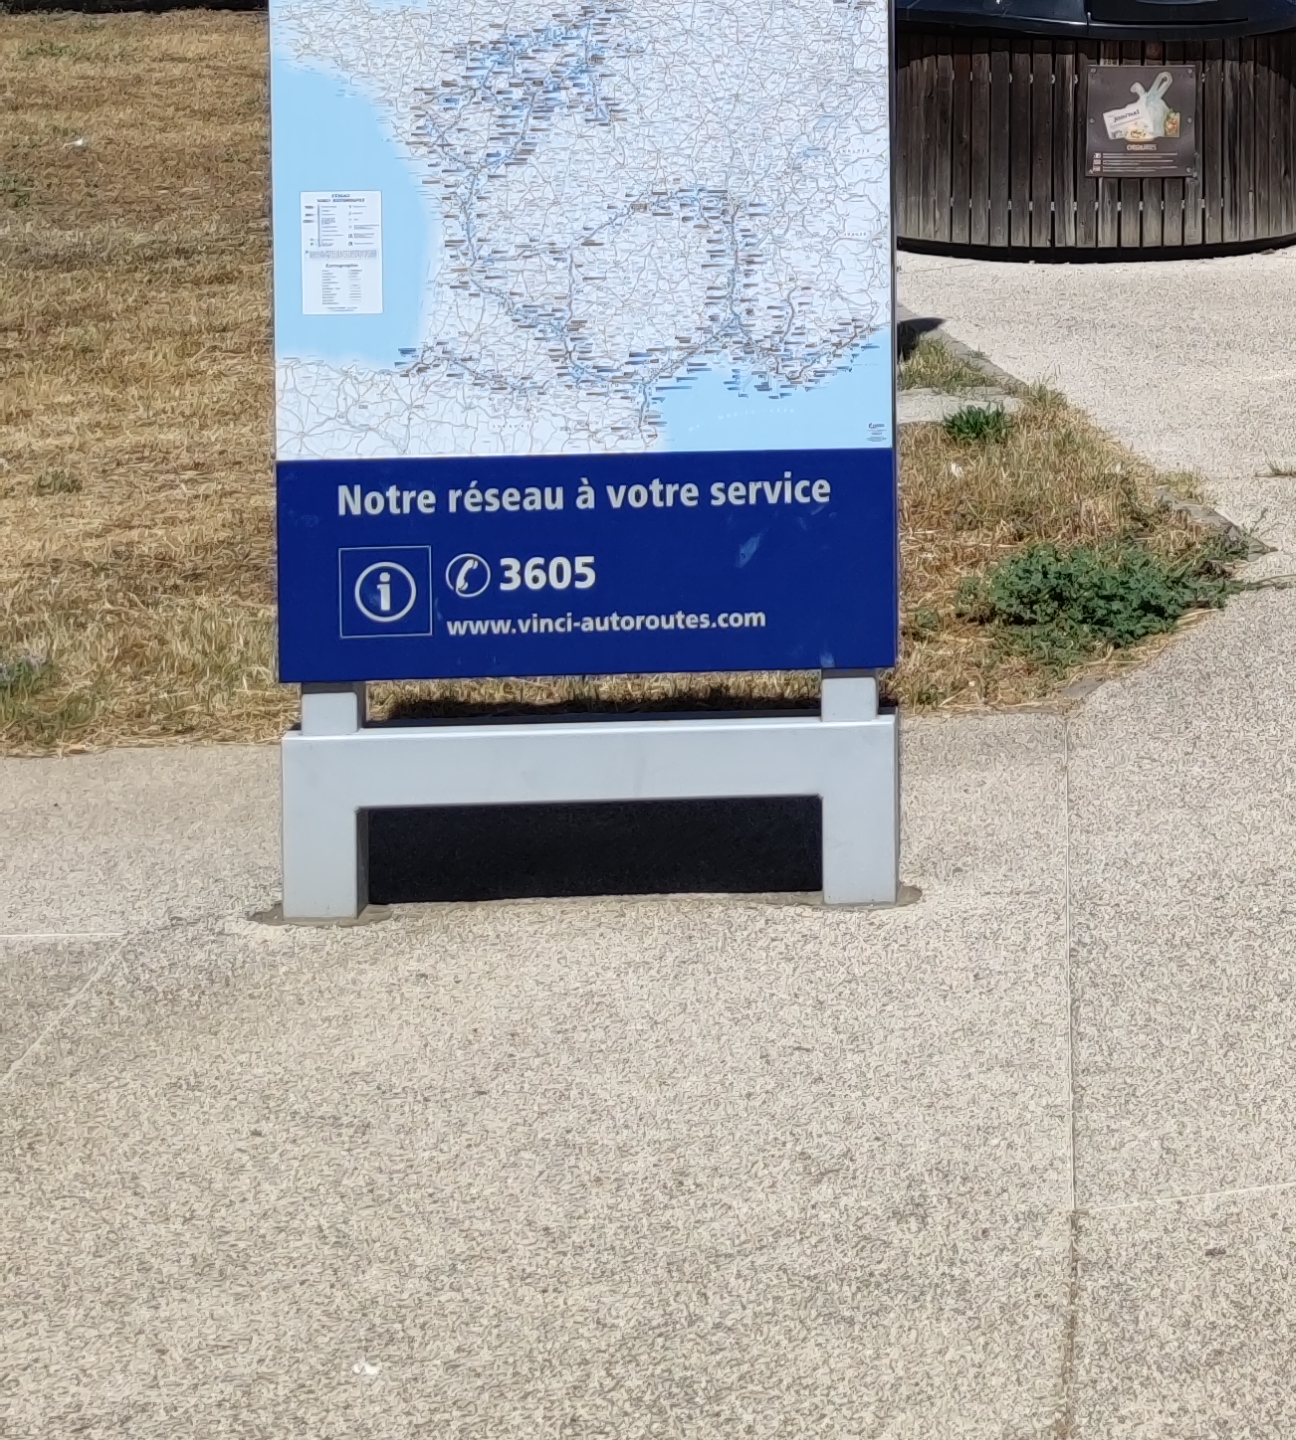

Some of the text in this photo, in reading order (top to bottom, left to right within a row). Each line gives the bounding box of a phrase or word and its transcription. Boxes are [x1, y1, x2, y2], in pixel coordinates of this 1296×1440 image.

[338, 470, 832, 517] Notre réseau à votre service
[499, 556, 597, 592] 3605
[447, 608, 767, 638] www.vinci-autoroutes.com
